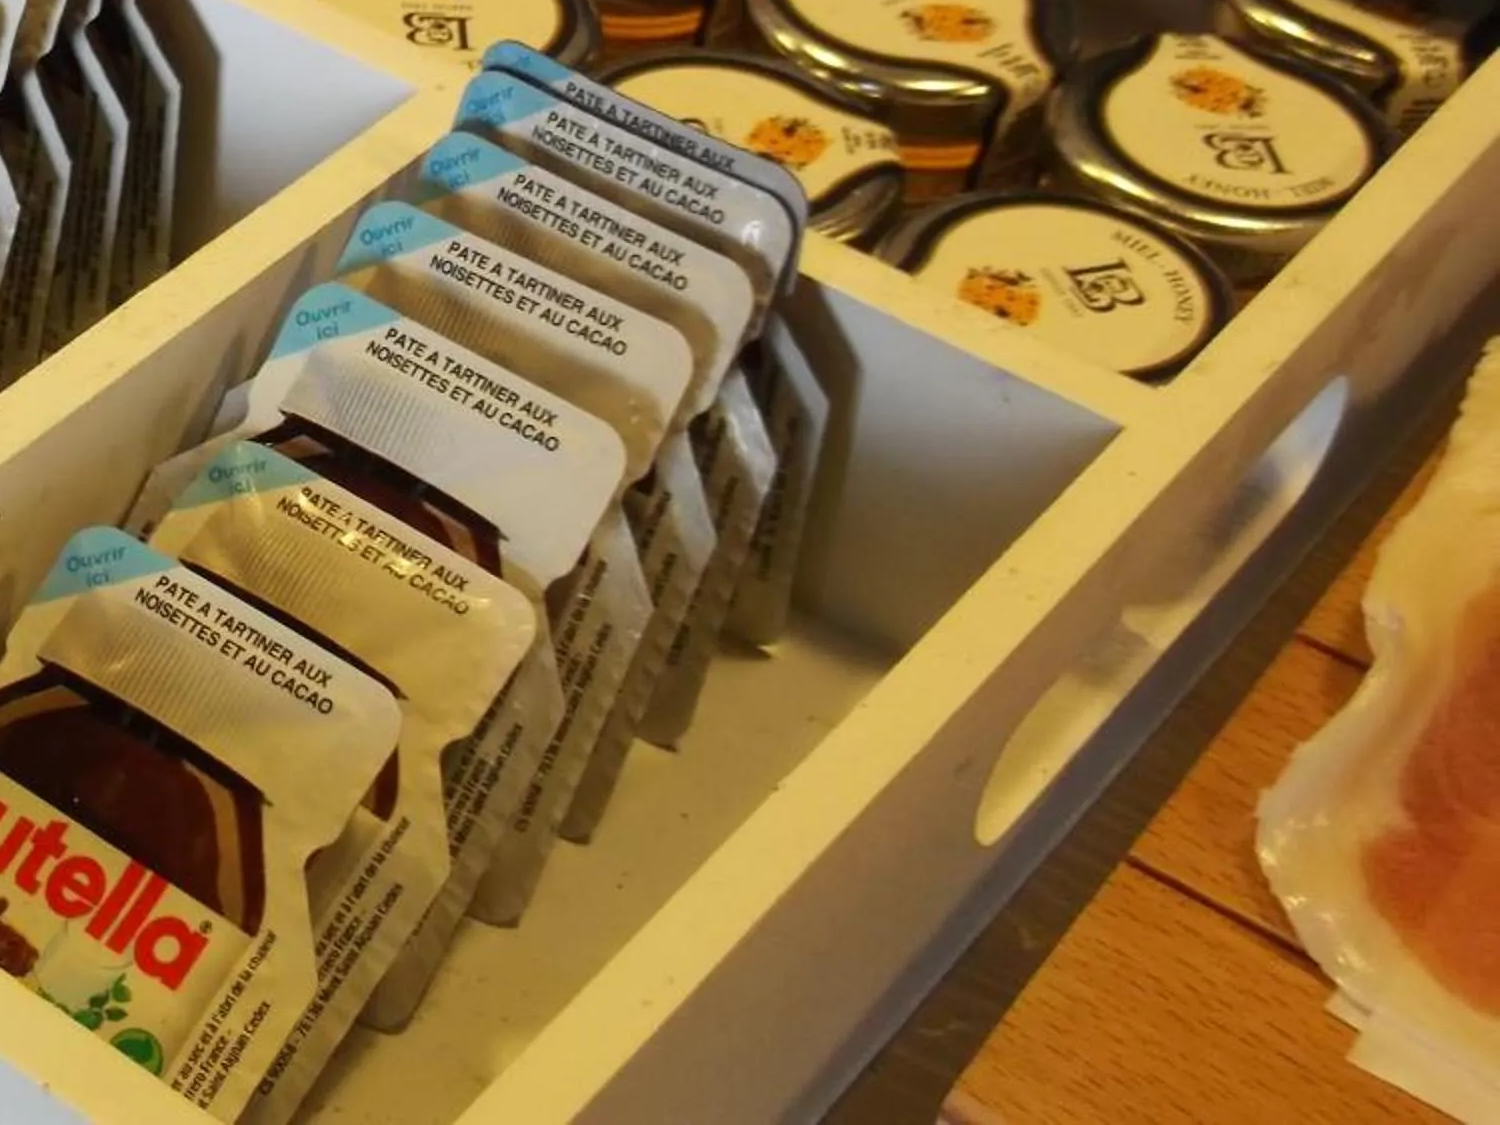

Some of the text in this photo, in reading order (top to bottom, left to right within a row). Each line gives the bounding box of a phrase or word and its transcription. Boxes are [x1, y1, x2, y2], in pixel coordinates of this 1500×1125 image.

[547, 111, 720, 200] PATE A TARTINER AUX
[565, 81, 604, 110] PATE
[700, 147, 737, 171] AUX
[513, 174, 686, 265] PATE A TARTINER AUX
[532, 125, 726, 225] NOISETTES ET AU CACAO
[447, 241, 625, 333] PATE A TARTINER AUX
[497, 187, 689, 292] NOISETTES ET AU CACAO
[1111, 230, 1196, 325] MIEL HONEY
[295, 300, 353, 327] Ouvrir
[315, 322, 340, 341] ici
[429, 254, 629, 357] NOISETTES ET AU CACAO
[365, 340, 561, 452] NOISETTES ET AU CACAO
[385, 327, 559, 428] PATE A TARTINER AUX
[66, 546, 127, 573] Ouvrir
[301, 486, 342, 517] PATE
[355, 517, 434, 571] TARTINER
[432, 564, 470, 592] AUX
[360, 544, 385, 565] ET
[409, 573, 471, 617] CACAO
[134, 587, 334, 715] NOISETTES ET AU CACAO
[155, 575, 334, 688] PATE A TARTINER AUX
